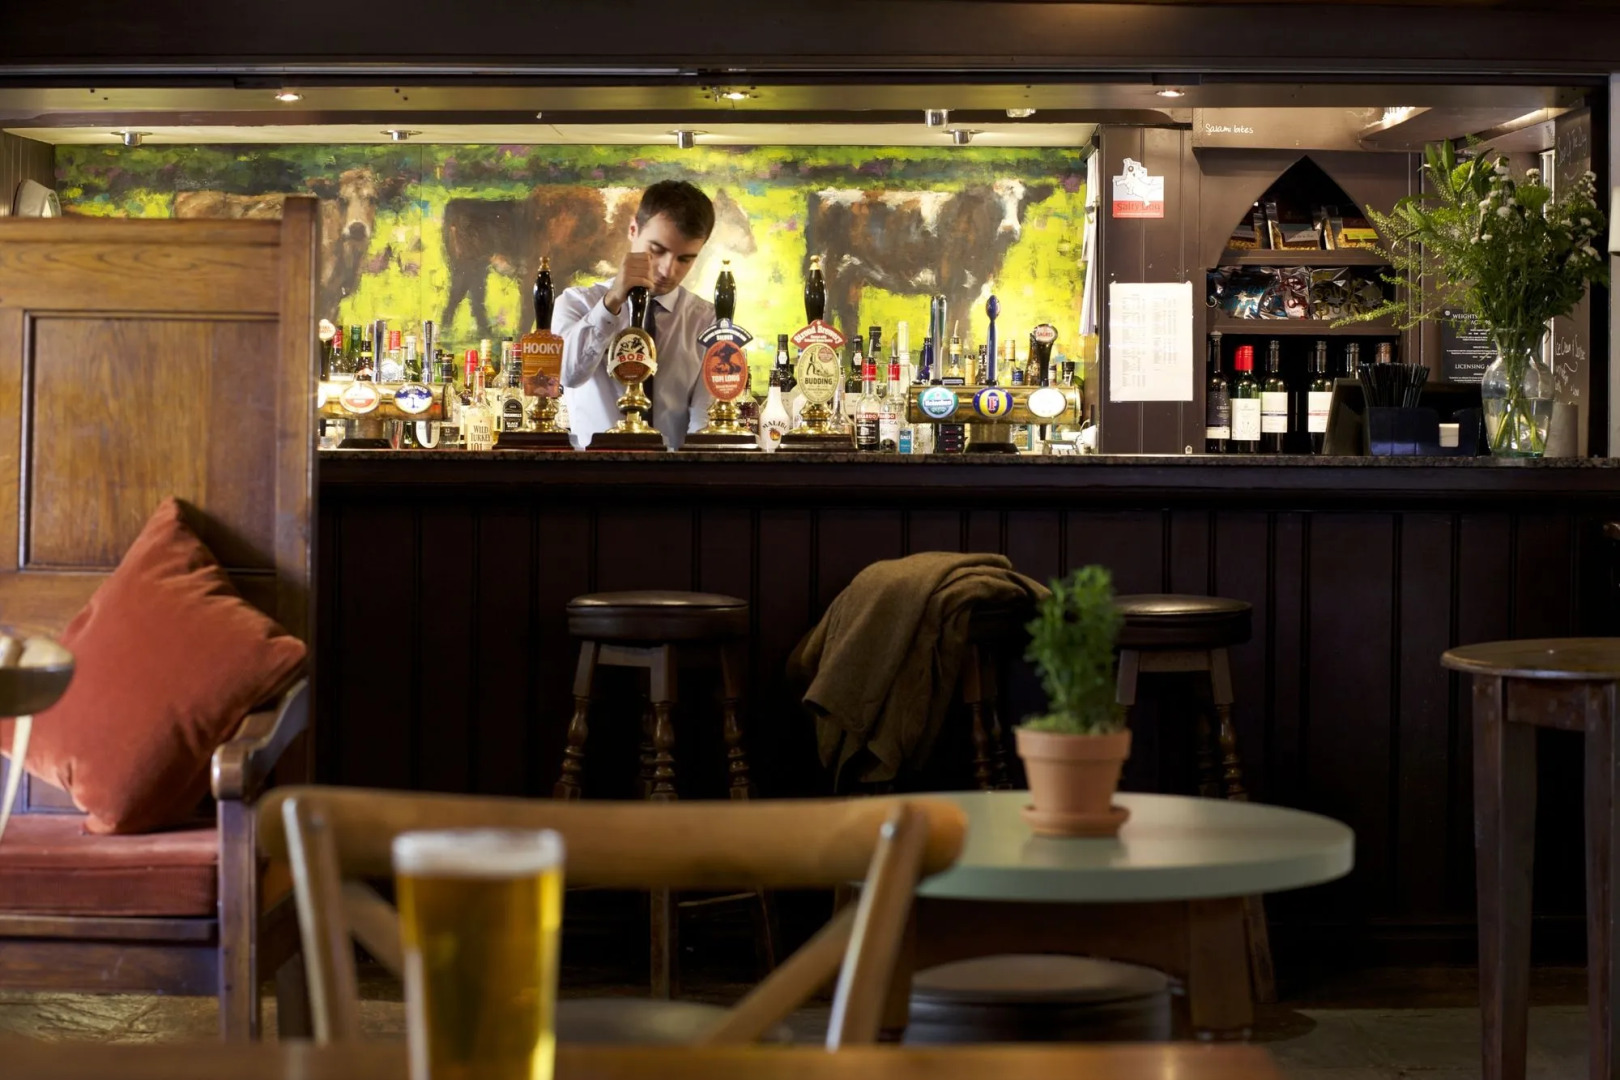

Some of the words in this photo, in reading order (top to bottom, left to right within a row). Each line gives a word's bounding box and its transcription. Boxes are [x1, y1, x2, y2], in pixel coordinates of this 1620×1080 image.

[1205, 123, 1232, 136] Salami
[1233, 124, 1254, 134] bites
[1116, 202, 1138, 211] Salty
[817, 325, 844, 345] Brewery
[523, 342, 563, 355] HOOKY
[618, 353, 644, 363] BOB
[804, 377, 833, 385] BUDDING
[473, 425, 489, 433] WILD
[470, 433, 491, 442] TURKEY
